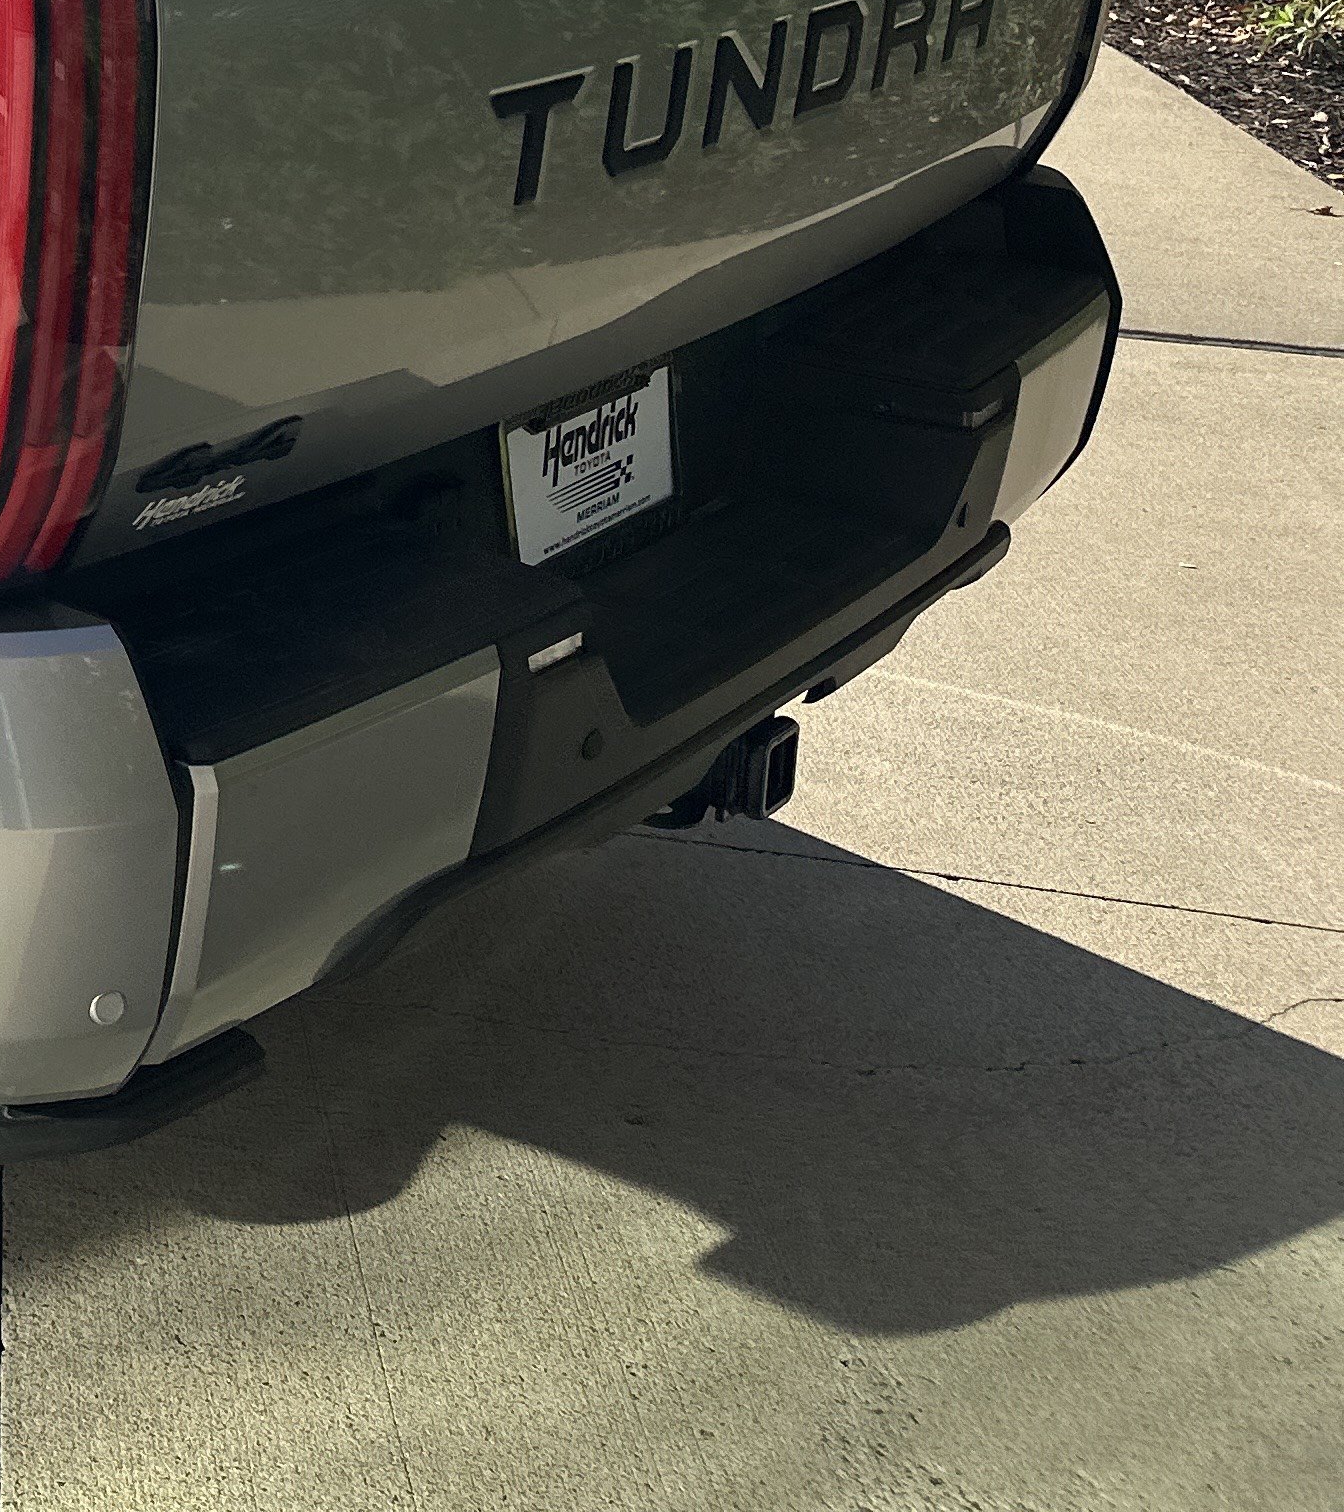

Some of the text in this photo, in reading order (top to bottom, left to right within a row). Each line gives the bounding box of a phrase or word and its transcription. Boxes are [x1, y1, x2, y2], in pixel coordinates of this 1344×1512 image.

[542, 393, 640, 488] Hendrick
[573, 450, 612, 477] TOYOTA
[132, 474, 247, 531] Hendrick
[575, 491, 621, 524] MERRIAM
